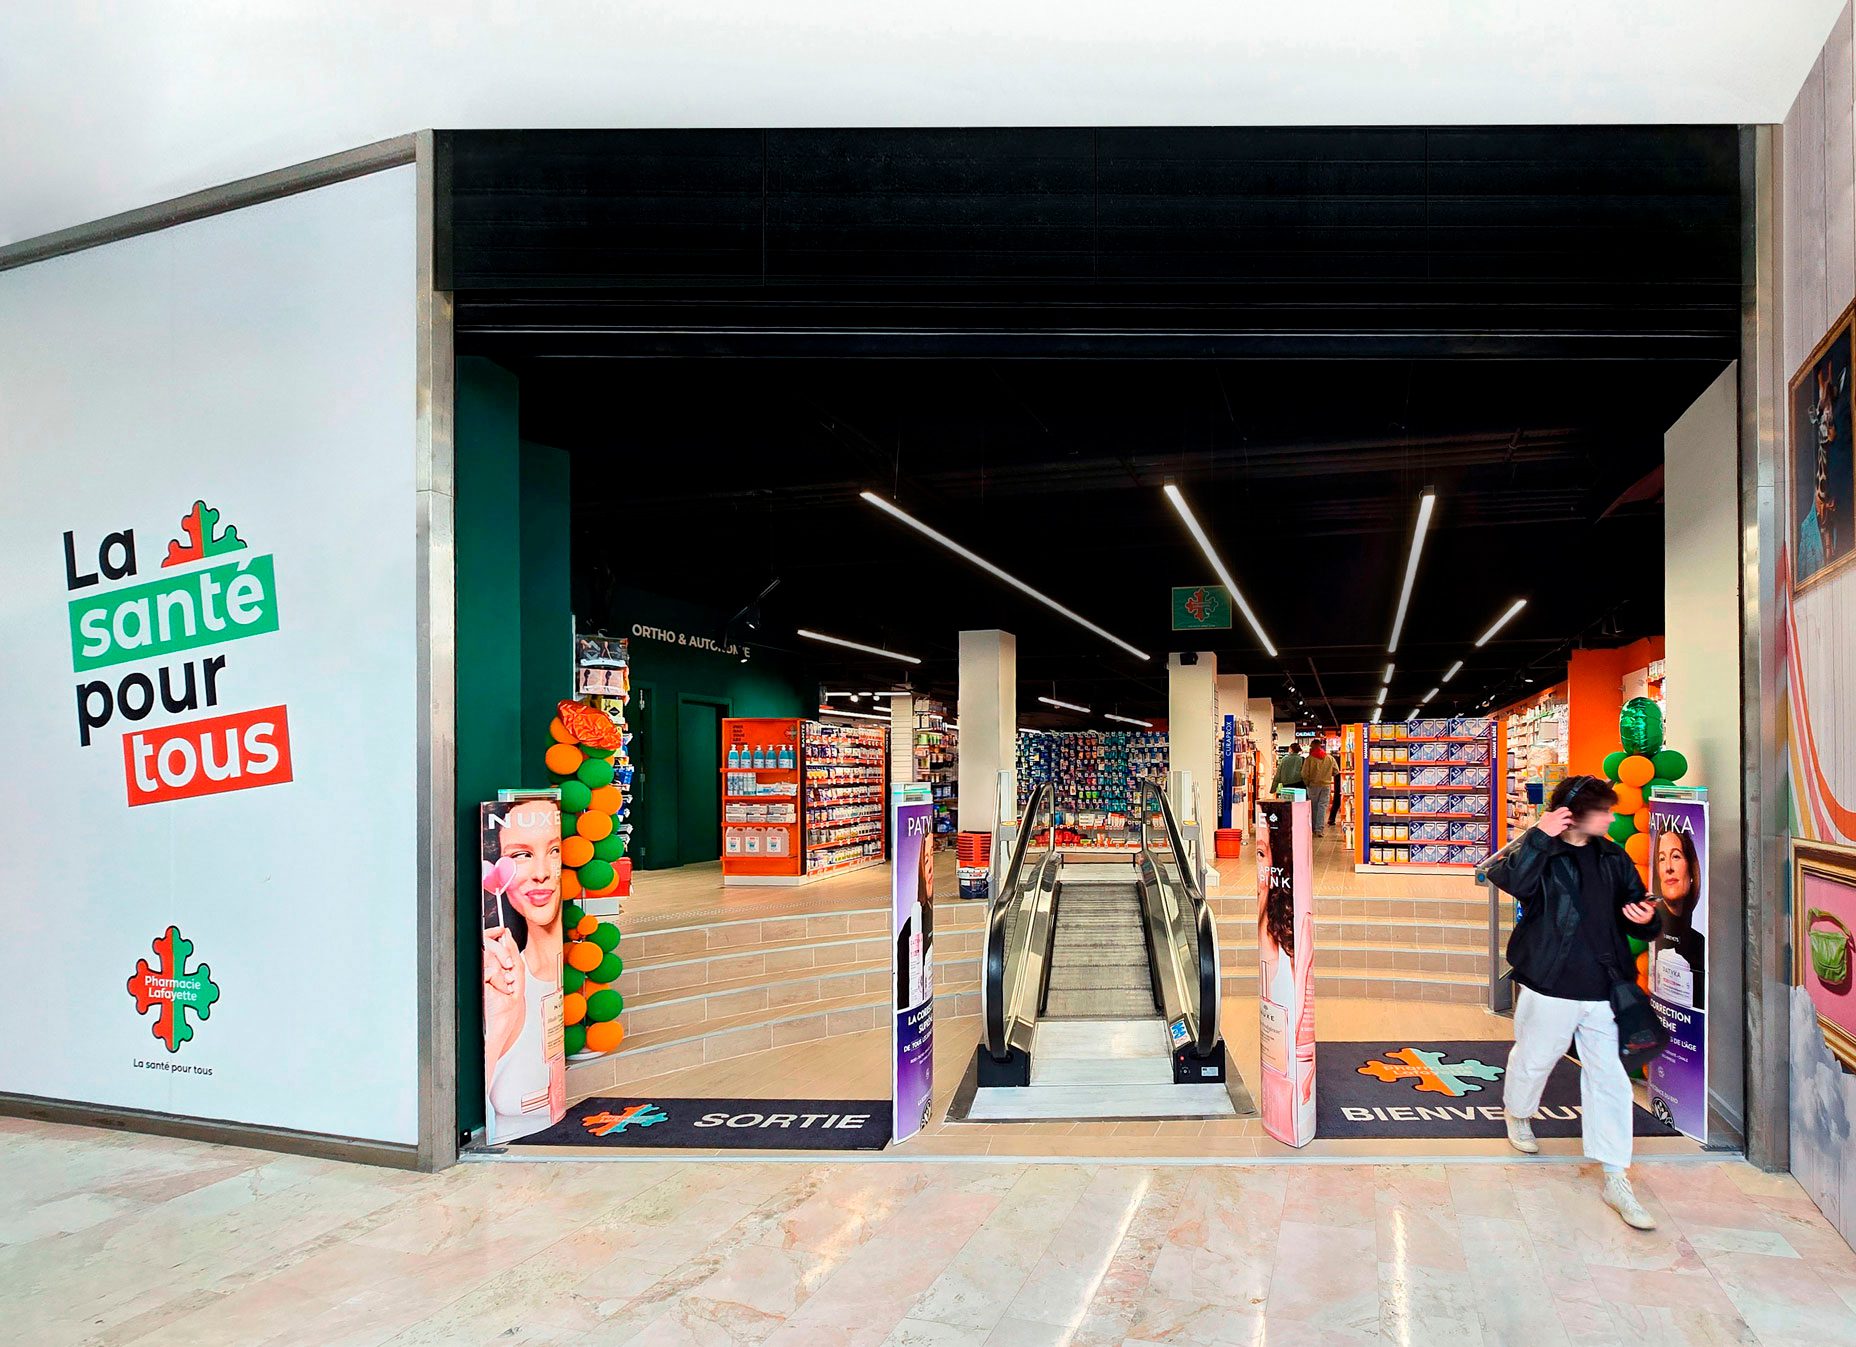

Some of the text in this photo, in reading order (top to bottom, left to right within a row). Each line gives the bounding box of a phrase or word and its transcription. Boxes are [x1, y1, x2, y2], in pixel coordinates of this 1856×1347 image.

[63, 528, 137, 590] La
[80, 557, 265, 657] santé
[632, 624, 675, 643] ORTHO
[678, 634, 687, 645] &
[76, 655, 226, 747] pour
[1225, 721, 1233, 757] CURAPROX
[133, 722, 279, 793] tous
[488, 811, 561, 829] NUXE
[908, 815, 932, 837] PATY
[1649, 812, 1694, 835] ATYKA
[1260, 874, 1291, 889] PINK
[144, 976, 201, 990] Pharmacie
[148, 988, 198, 1001] Lafayette
[133, 1058, 213, 1076] La santé pour tous
[693, 1113, 871, 1129] SORTIE
[1340, 1105, 1583, 1121] BIENVEU
